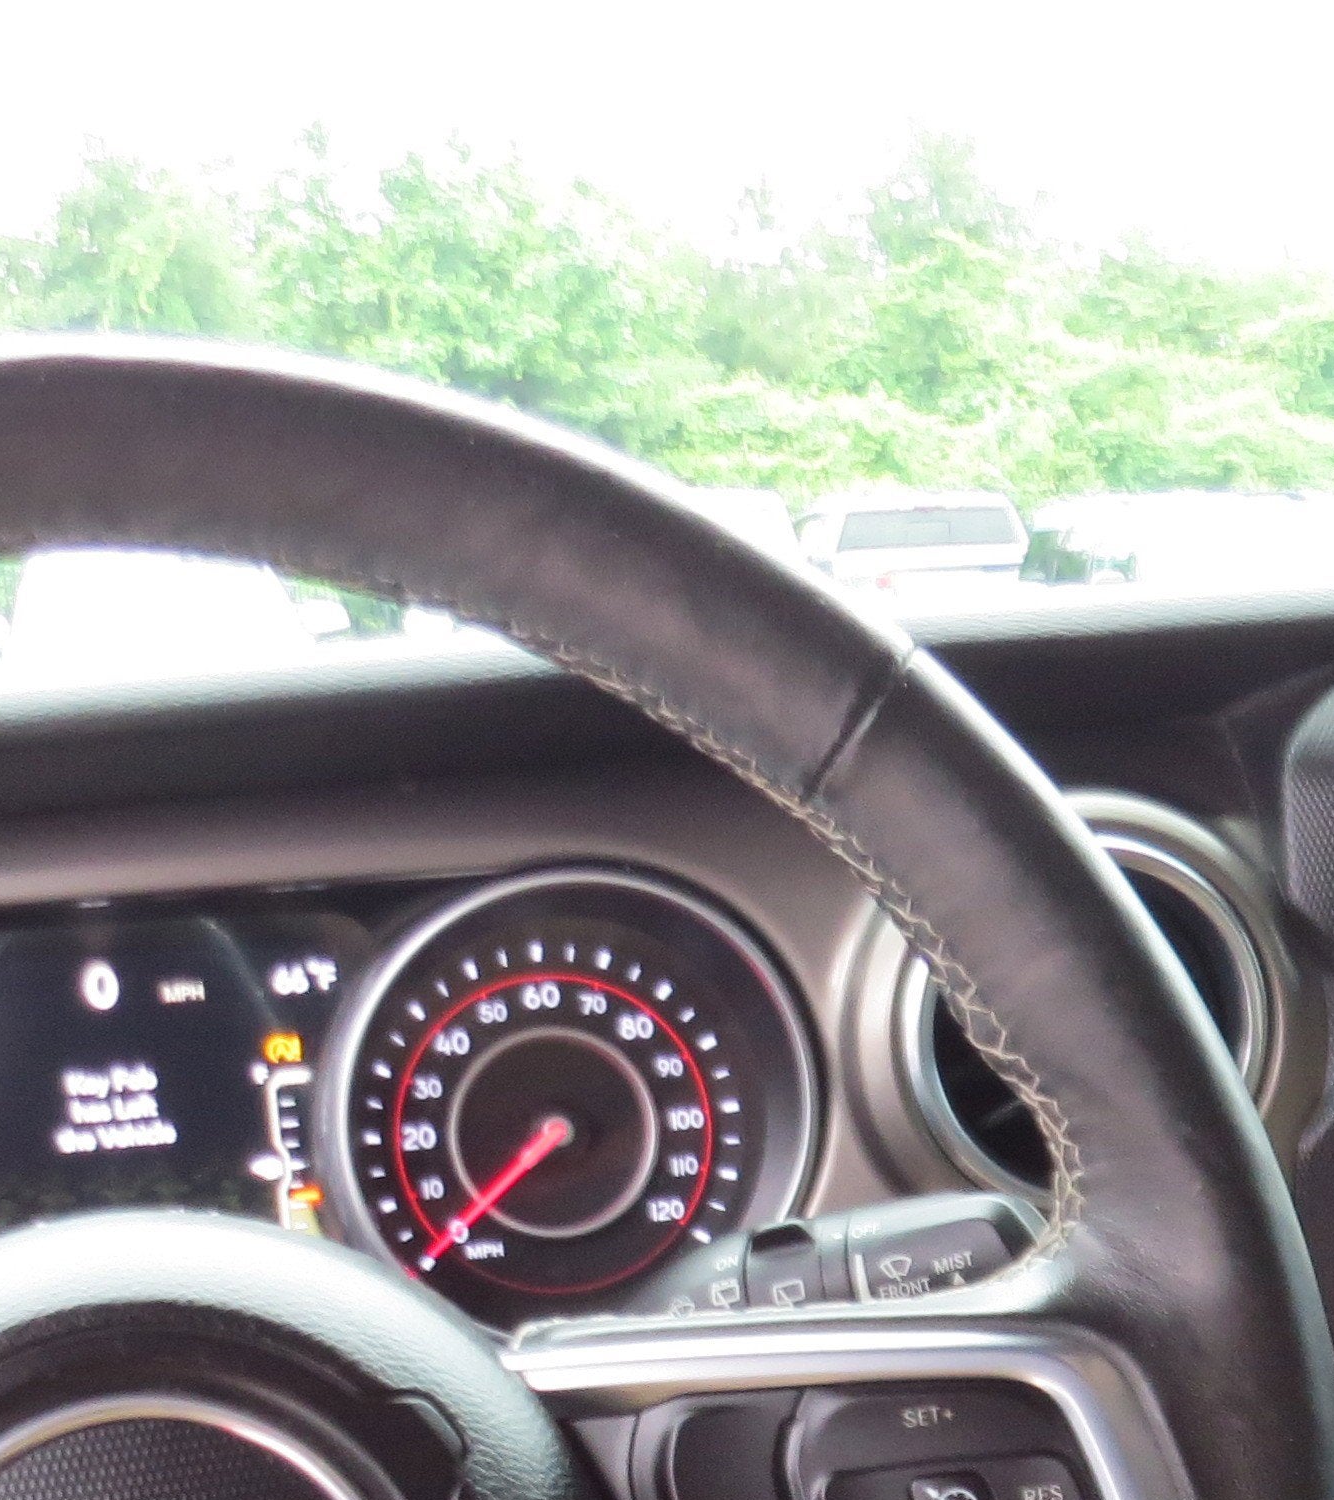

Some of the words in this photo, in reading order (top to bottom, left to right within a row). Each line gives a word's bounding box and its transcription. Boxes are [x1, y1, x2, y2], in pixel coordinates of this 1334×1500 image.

[82, 961, 119, 1010] 0
[522, 986, 561, 1009] 60
[578, 992, 608, 1015] 70
[477, 1002, 508, 1024] 50
[617, 1014, 655, 1040] 80
[434, 1030, 470, 1055] 40
[653, 1055, 684, 1078] 90
[411, 1076, 442, 1100] 30
[669, 1108, 705, 1132] 100
[402, 1125, 437, 1150] 20
[669, 1155, 700, 1177] 110
[419, 1178, 445, 1200] 10
[647, 1199, 684, 1223] 120
[466, 1241, 505, 1261] MPH
[931, 1250, 973, 1275] MIST
[715, 1253, 740, 1273] ON
[877, 1277, 931, 1300] FRONT
